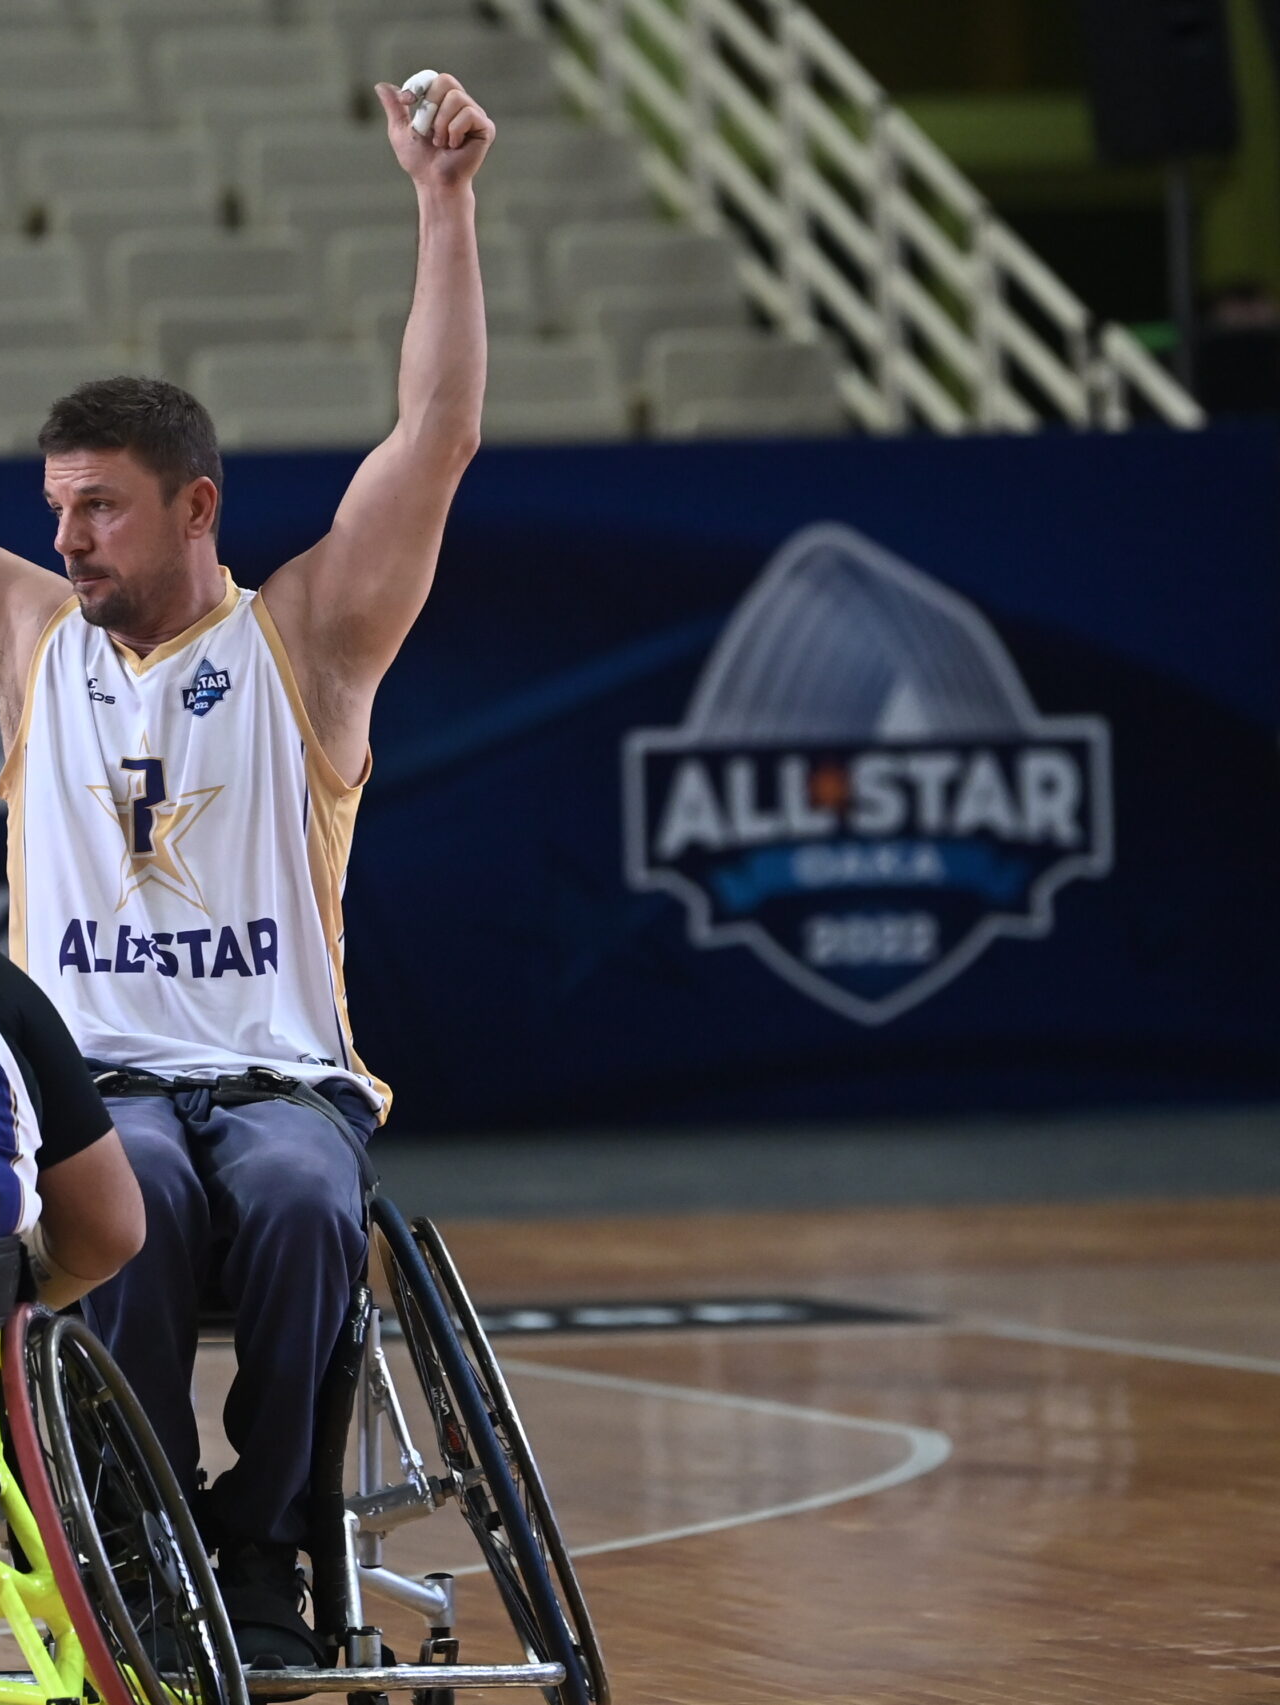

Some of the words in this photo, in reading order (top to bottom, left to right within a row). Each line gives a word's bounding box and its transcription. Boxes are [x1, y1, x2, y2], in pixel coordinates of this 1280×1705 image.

[657, 757, 826, 860] ALL
[850, 749, 1082, 842] STAR
[60, 918, 146, 976] ALL
[154, 917, 278, 978] STAR
